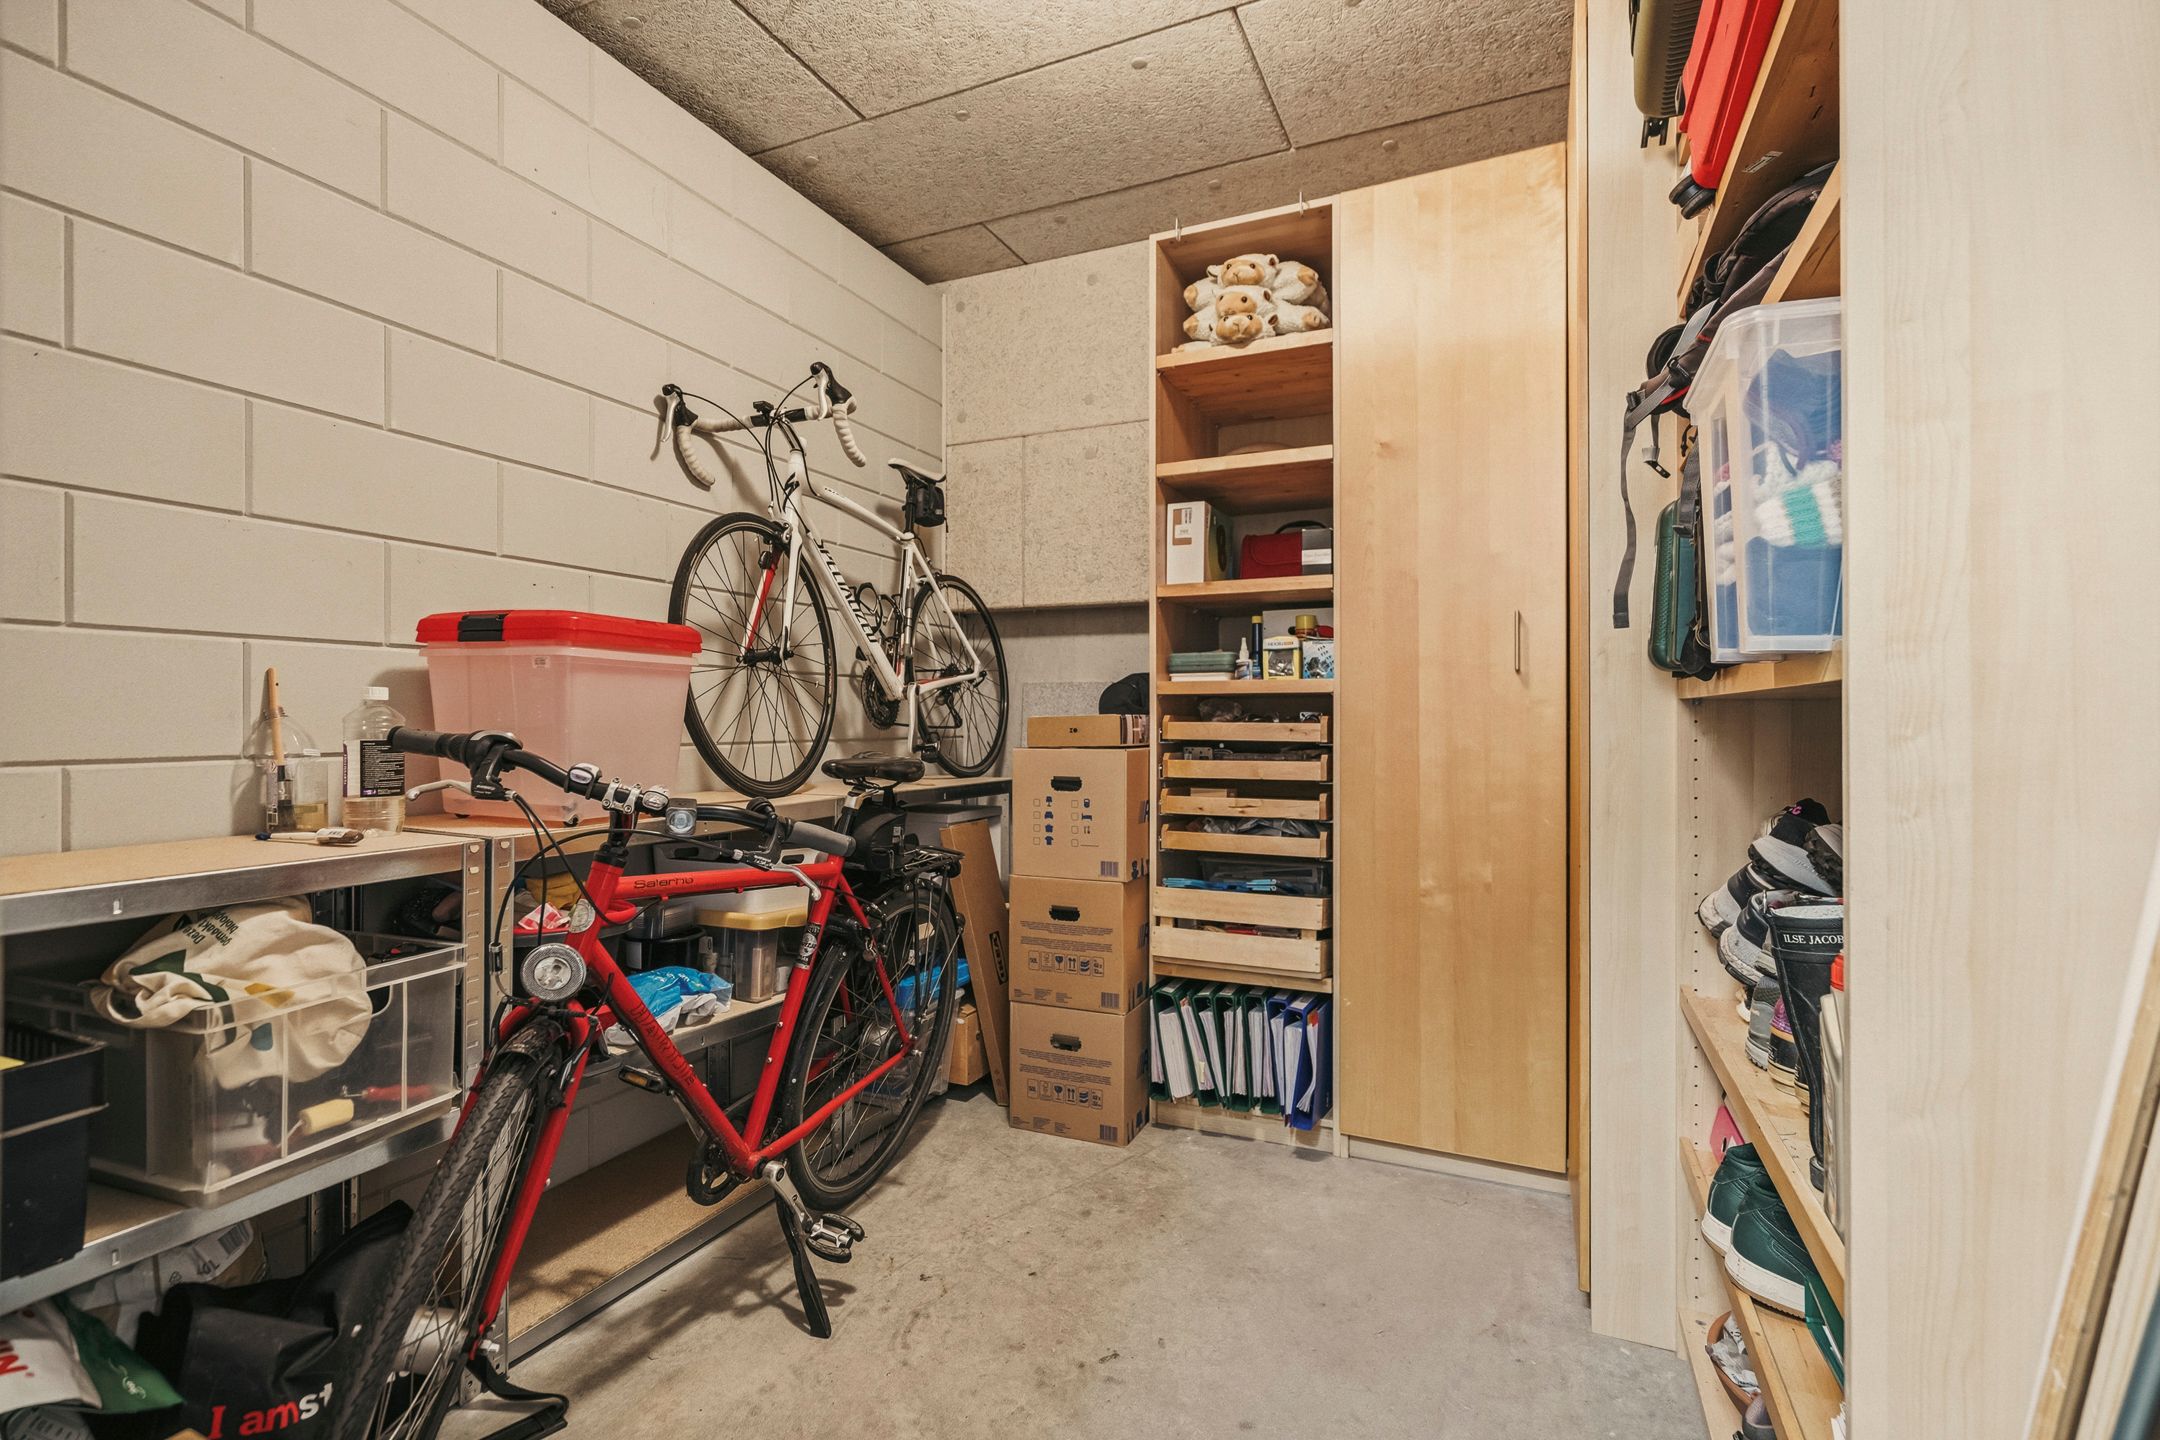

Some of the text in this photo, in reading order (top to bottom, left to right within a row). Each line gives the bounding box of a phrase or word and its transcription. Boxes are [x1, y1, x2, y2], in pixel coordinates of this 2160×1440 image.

[634, 877, 695, 889] Salerno
[1783, 934, 1807, 944] ILSE
[207, 1404, 226, 1440] I
